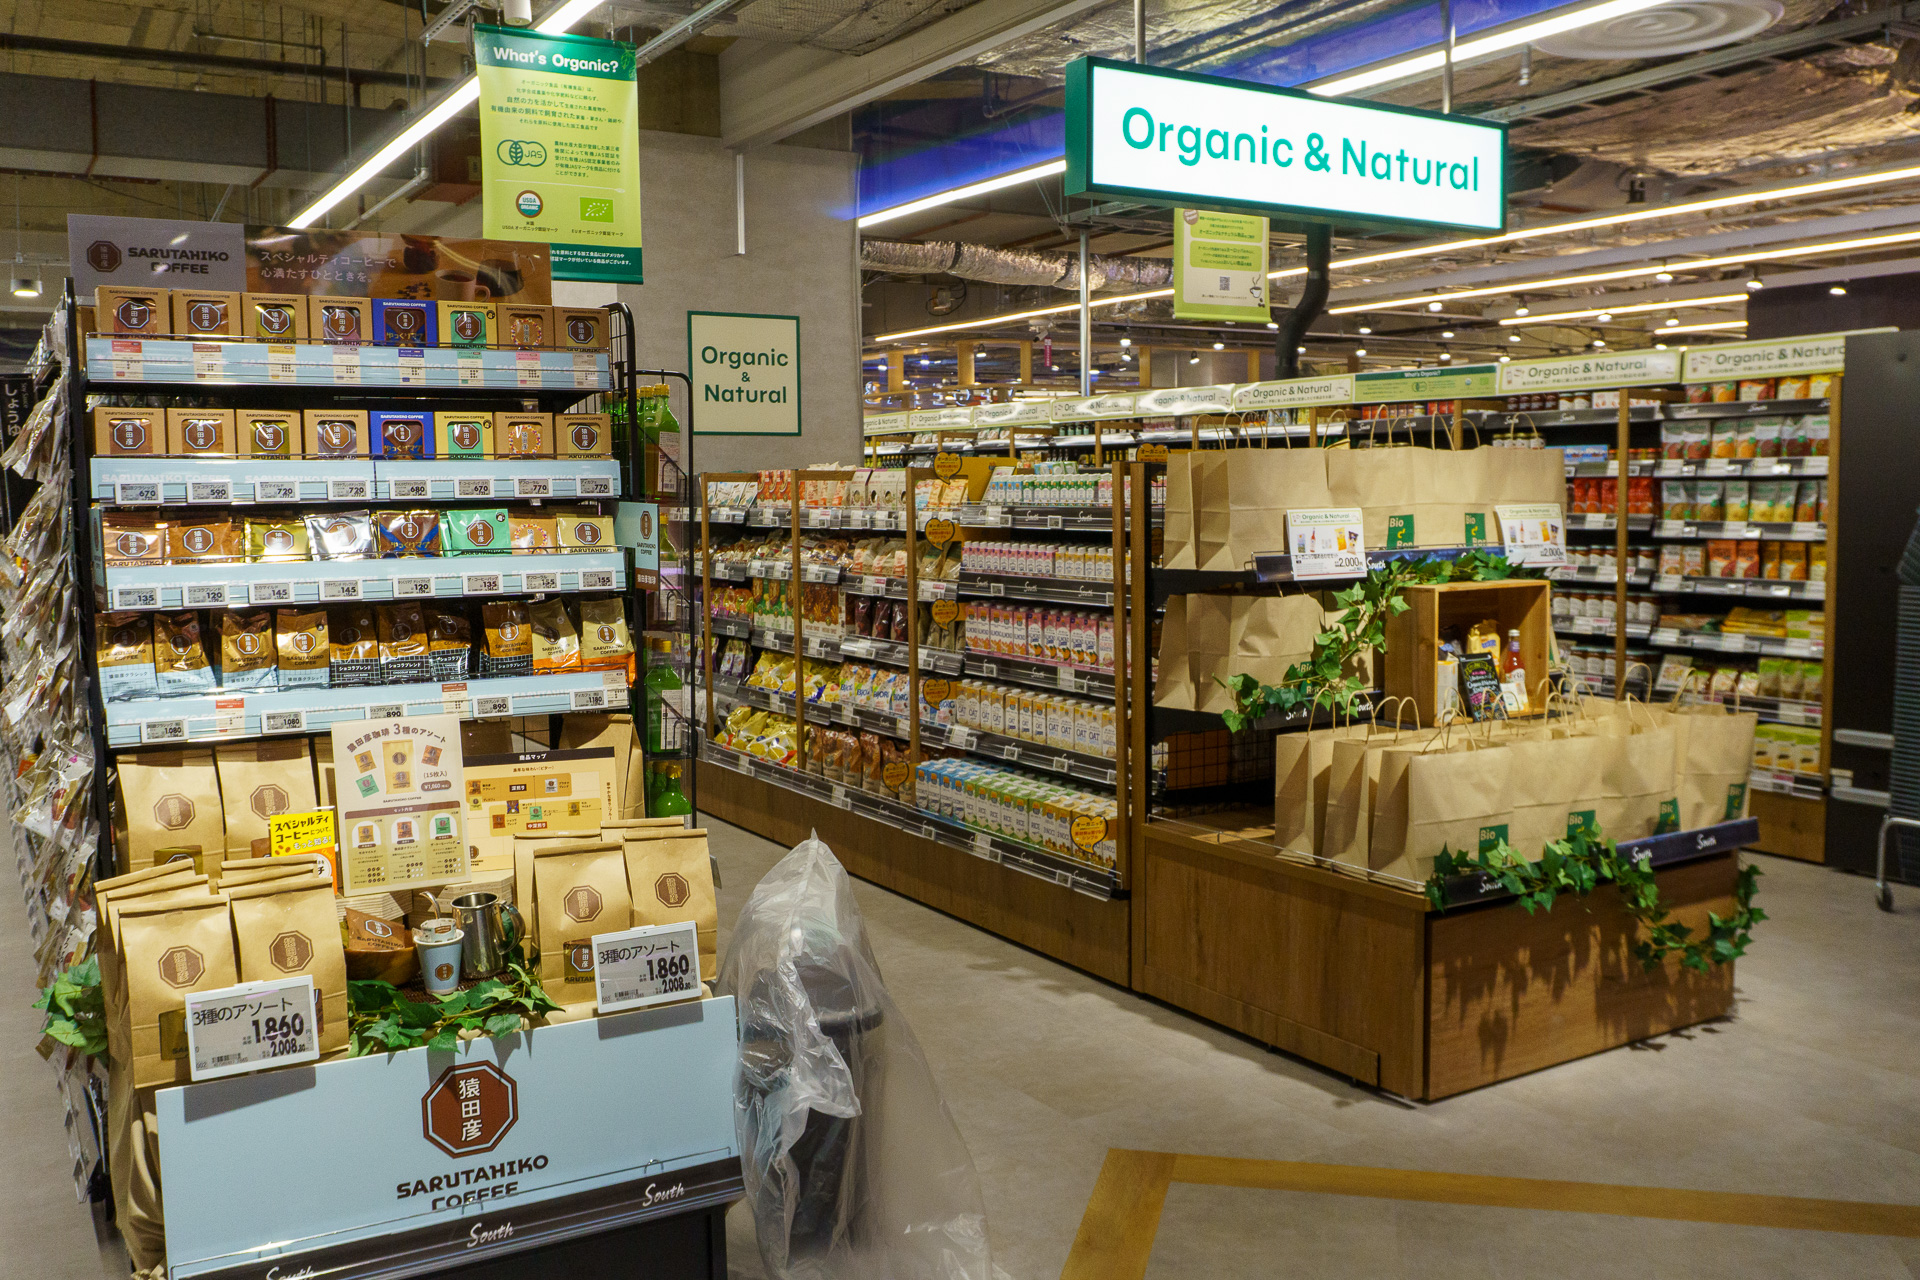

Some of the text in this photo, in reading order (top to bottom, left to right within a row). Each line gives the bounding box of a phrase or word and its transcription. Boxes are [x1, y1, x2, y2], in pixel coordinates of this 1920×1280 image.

[493, 47, 618, 73] What's Organic?
[1122, 107, 1479, 191] Organic & Natural
[128, 248, 229, 262] SARUTAHIKO
[261, 251, 396, 269] スペシャルティコーヒーで
[151, 263, 209, 274] COFFEE
[701, 346, 788, 369] Organic
[1717, 345, 1845, 366] Organic & Natura
[1528, 358, 1647, 378] Organic & Natural
[741, 372, 750, 382] &
[705, 384, 786, 403] Natural
[1253, 389, 1287, 400] Organic
[1289, 387, 1295, 395] &
[1297, 383, 1332, 395] Natural
[919, 414, 937, 422] Organic
[125, 425, 133, 445] 猿田彦
[1389, 518, 1404, 527] Bio
[1466, 515, 1476, 524] Bio
[194, 532, 202, 550] 猿田彦
[1339, 558, 1359, 567] 2,000
[1061, 725, 1072, 735] OAT
[1076, 728, 1087, 738] OAT
[1089, 731, 1100, 741] OAT
[519, 753, 547, 761] 商品マップ
[275, 815, 329, 832] スペシャルティ
[1003, 814, 1012, 824] RICE
[1031, 822, 1040, 832] RICE
[1568, 814, 1583, 826] Bio
[1480, 829, 1496, 840] Bio
[599, 941, 679, 964] 3種のアソート
[193, 997, 292, 1026] 3種のアソート
[458, 1077, 484, 1142] 猿田彦
[396, 1155, 549, 1200] SARUTAHIKO
[642, 1182, 686, 1208] South
[466, 1222, 514, 1249] South
